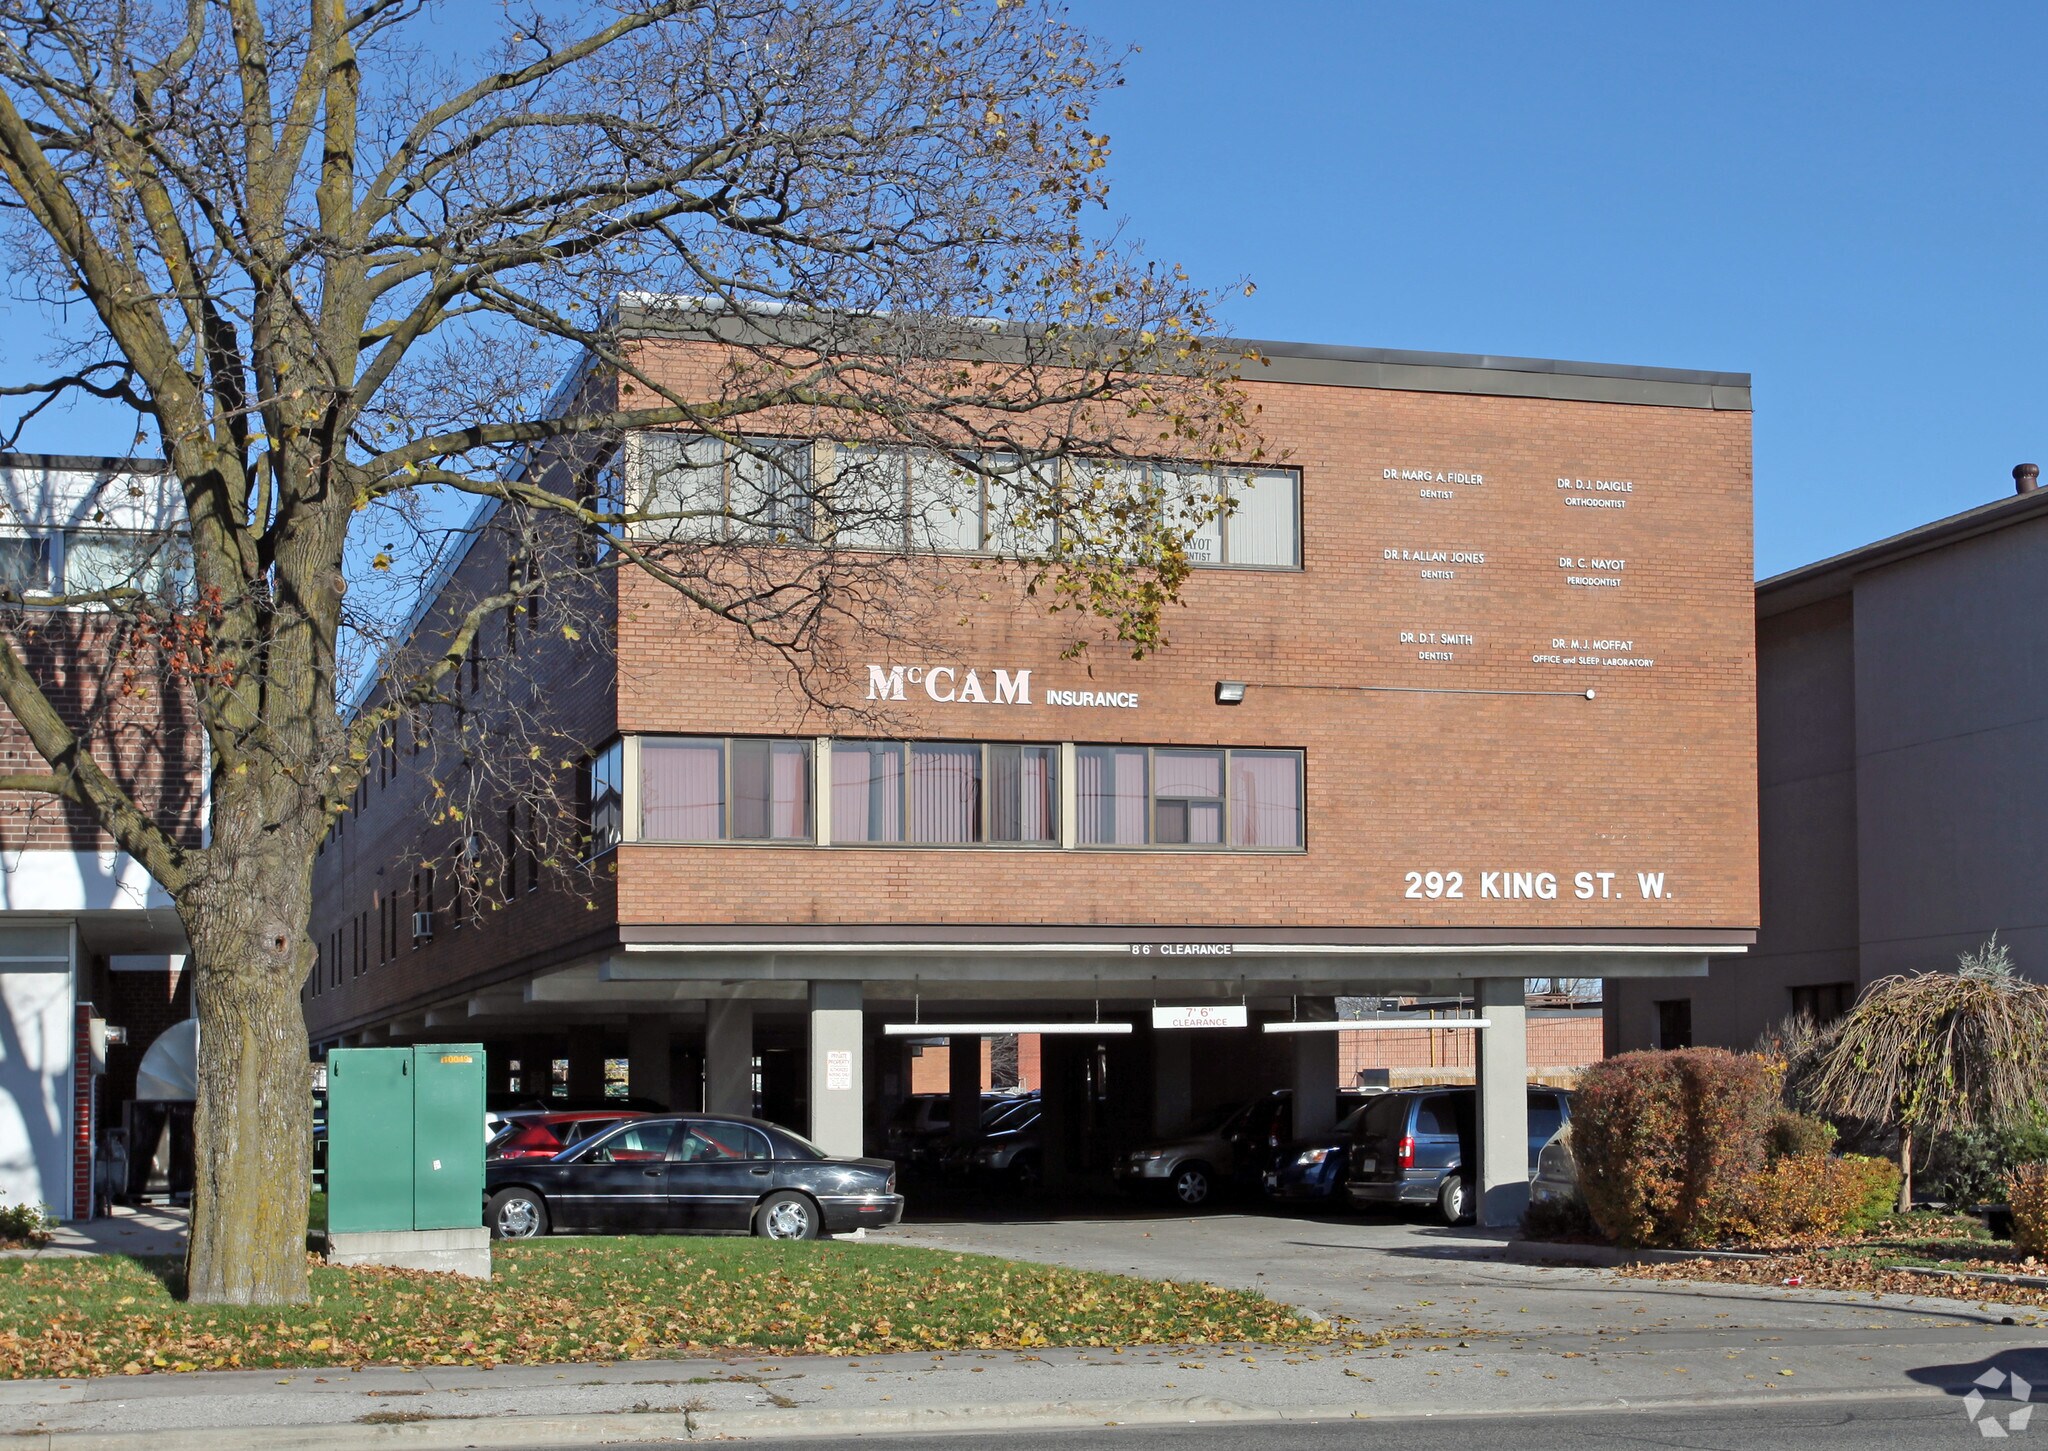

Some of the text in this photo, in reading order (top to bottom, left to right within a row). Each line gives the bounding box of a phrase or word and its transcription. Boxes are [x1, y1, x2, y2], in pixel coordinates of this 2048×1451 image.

[1383, 468, 1399, 480] DR.
[1401, 469, 1433, 482] MARG
[1557, 477, 1573, 489] DR.
[1596, 479, 1633, 492] DAIGLE
[1419, 488, 1454, 500] DENTIST
[1564, 497, 1627, 509] ORTHODONTIST
[1384, 548, 1400, 560] DR.
[1450, 551, 1485, 565] JONES
[1559, 556, 1626, 570] DR. C. NAYOT
[1421, 569, 1455, 581] DENTIST
[1566, 576, 1622, 588] PERIODONTIST
[1400, 631, 1418, 643] DR.
[1440, 633, 1473, 645] SMITH
[1552, 638, 1569, 649] DR.
[1592, 639, 1634, 651] MOFFAT
[1418, 651, 1454, 661] DENTIST
[1532, 654, 1654, 667] OFFICE and SLEEP LABORATORY
[1046, 689, 1139, 708] INSURANCE
[1404, 870, 1672, 901] 292 KING ST. W.
[1160, 944, 1232, 955] CLEARANCE
[1172, 1018, 1228, 1027] CLEARANCE
